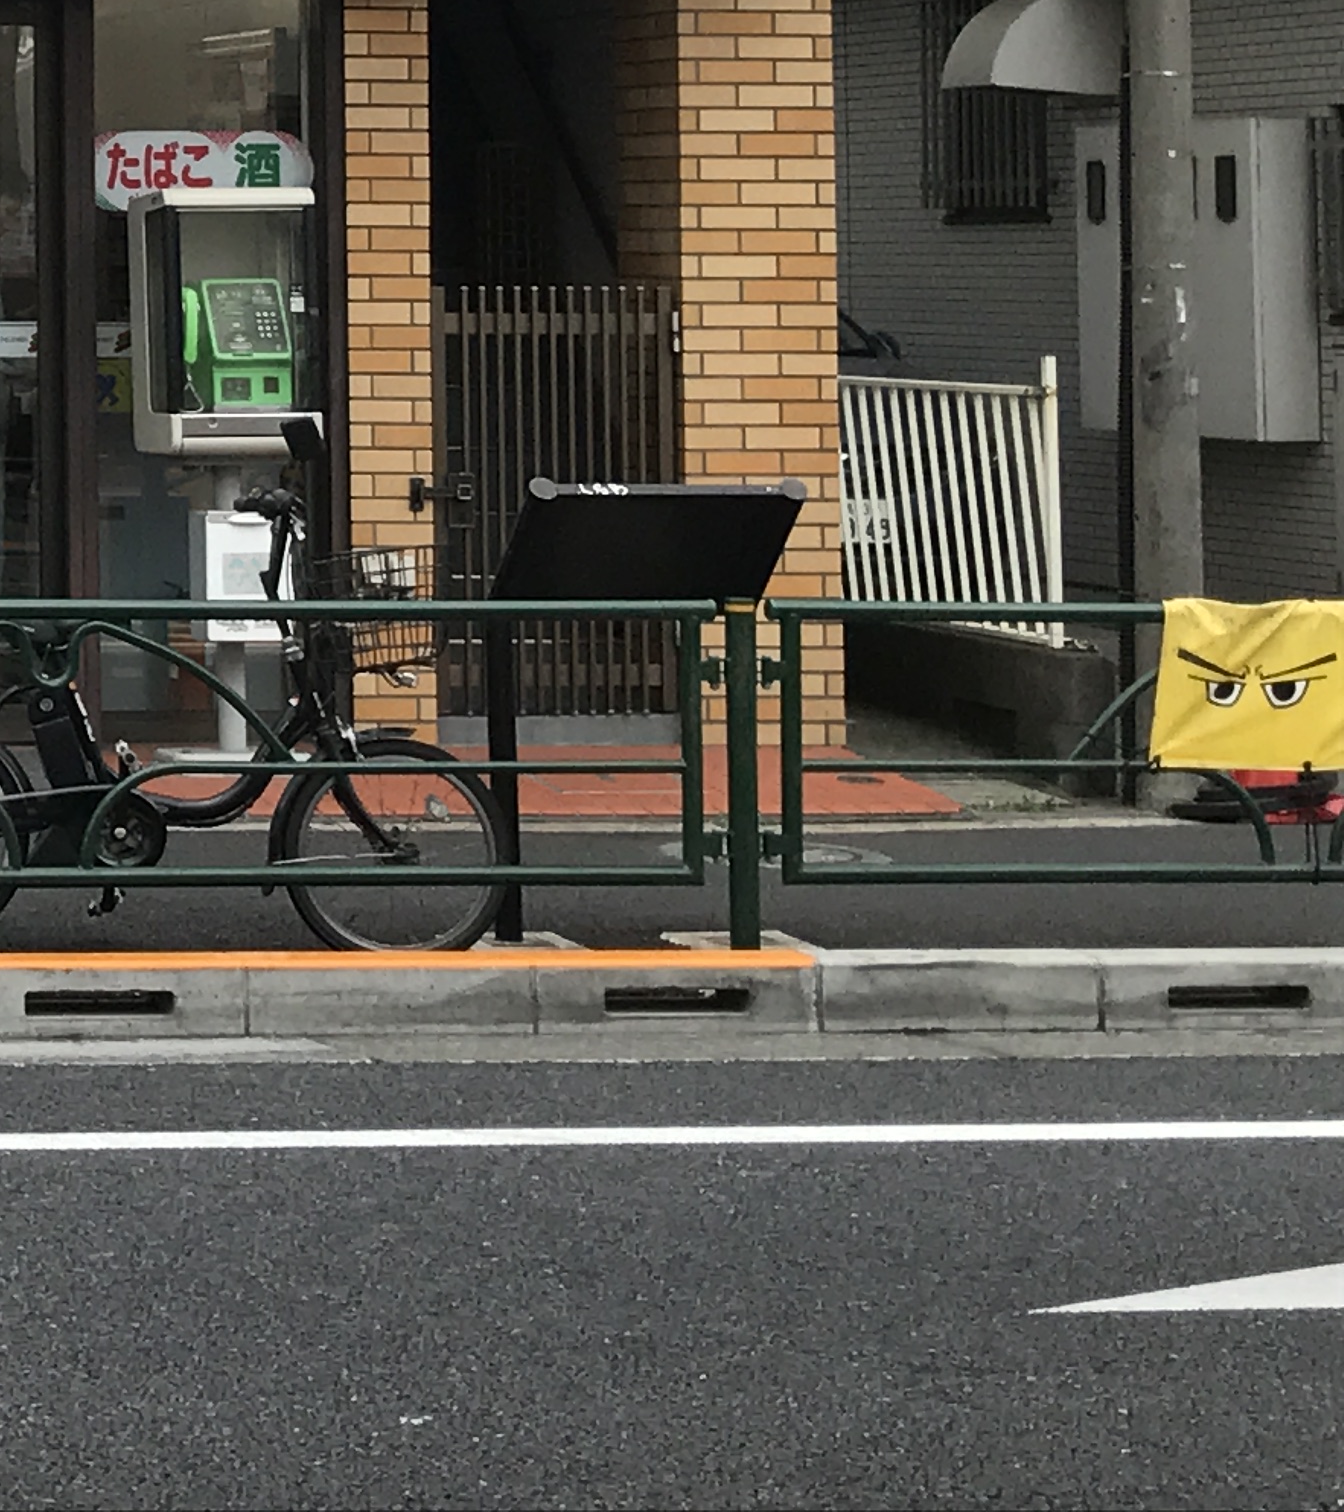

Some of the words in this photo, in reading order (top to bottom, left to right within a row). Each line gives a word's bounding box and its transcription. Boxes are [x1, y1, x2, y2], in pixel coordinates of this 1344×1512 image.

[106, 141, 214, 190] たばこ
[234, 142, 282, 189] 酒
